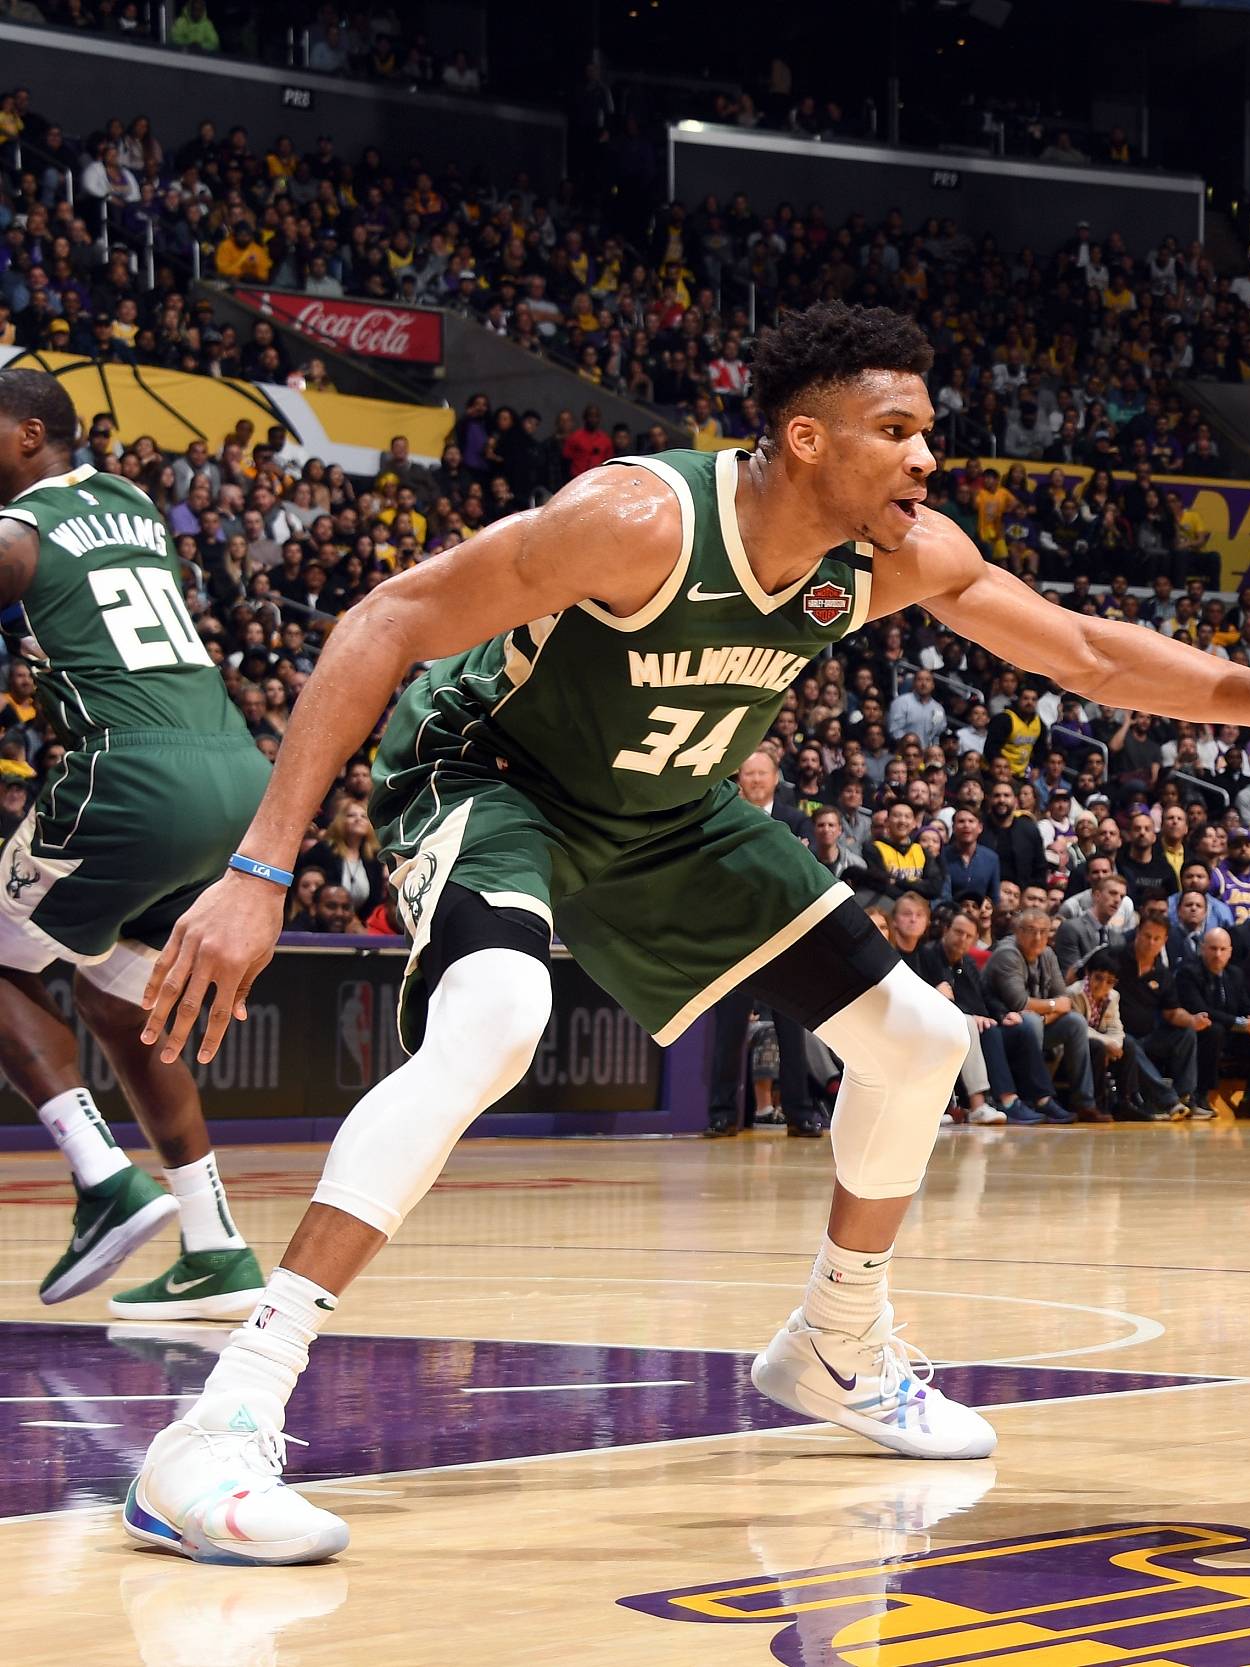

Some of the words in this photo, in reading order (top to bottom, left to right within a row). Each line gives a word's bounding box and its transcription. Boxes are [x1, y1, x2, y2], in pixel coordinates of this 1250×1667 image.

[48, 512, 168, 558] WILLIAMS
[87, 566, 217, 672] 20
[627, 646, 811, 693] MILWAUKE
[612, 705, 750, 777] 34
[252, 864, 271, 878] LCA
